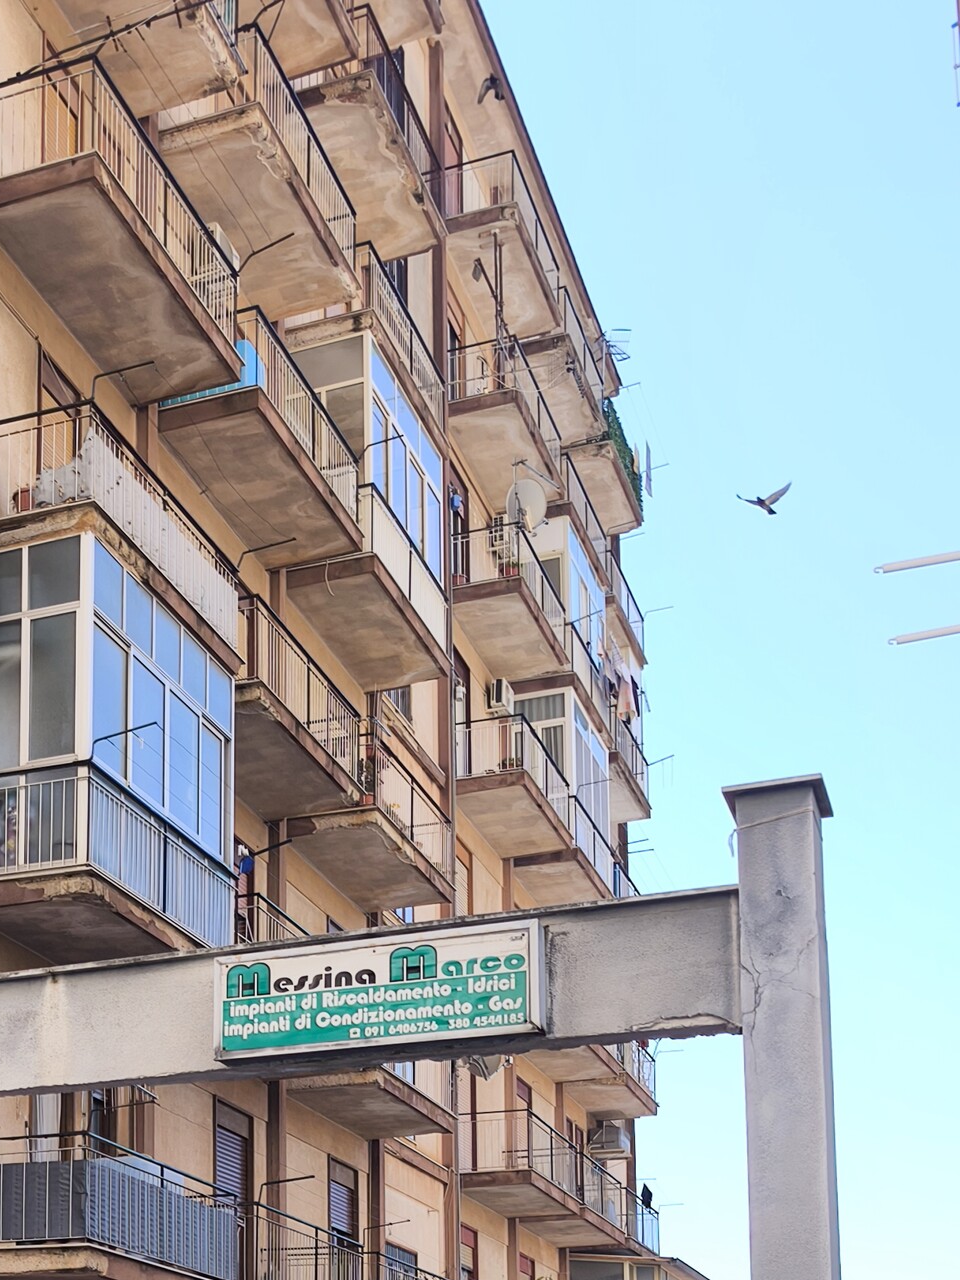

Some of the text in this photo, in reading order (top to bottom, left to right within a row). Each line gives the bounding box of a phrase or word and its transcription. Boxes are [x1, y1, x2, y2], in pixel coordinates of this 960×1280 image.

[226, 944, 526, 998] Messina Marco
[223, 1014, 290, 1040] impianti
[294, 1013, 311, 1030] di
[315, 1000, 473, 1028] Condizionamento
[488, 995, 523, 1012] Gas
[229, 995, 297, 1020] impianti
[300, 993, 317, 1010] di
[321, 981, 451, 1008] Riscaldamento
[467, 973, 515, 994] Idrici
[364, 1026, 384, 1037] 091
[448, 1017, 470, 1030] 380
[473, 1013, 524, 1028] 4544185
